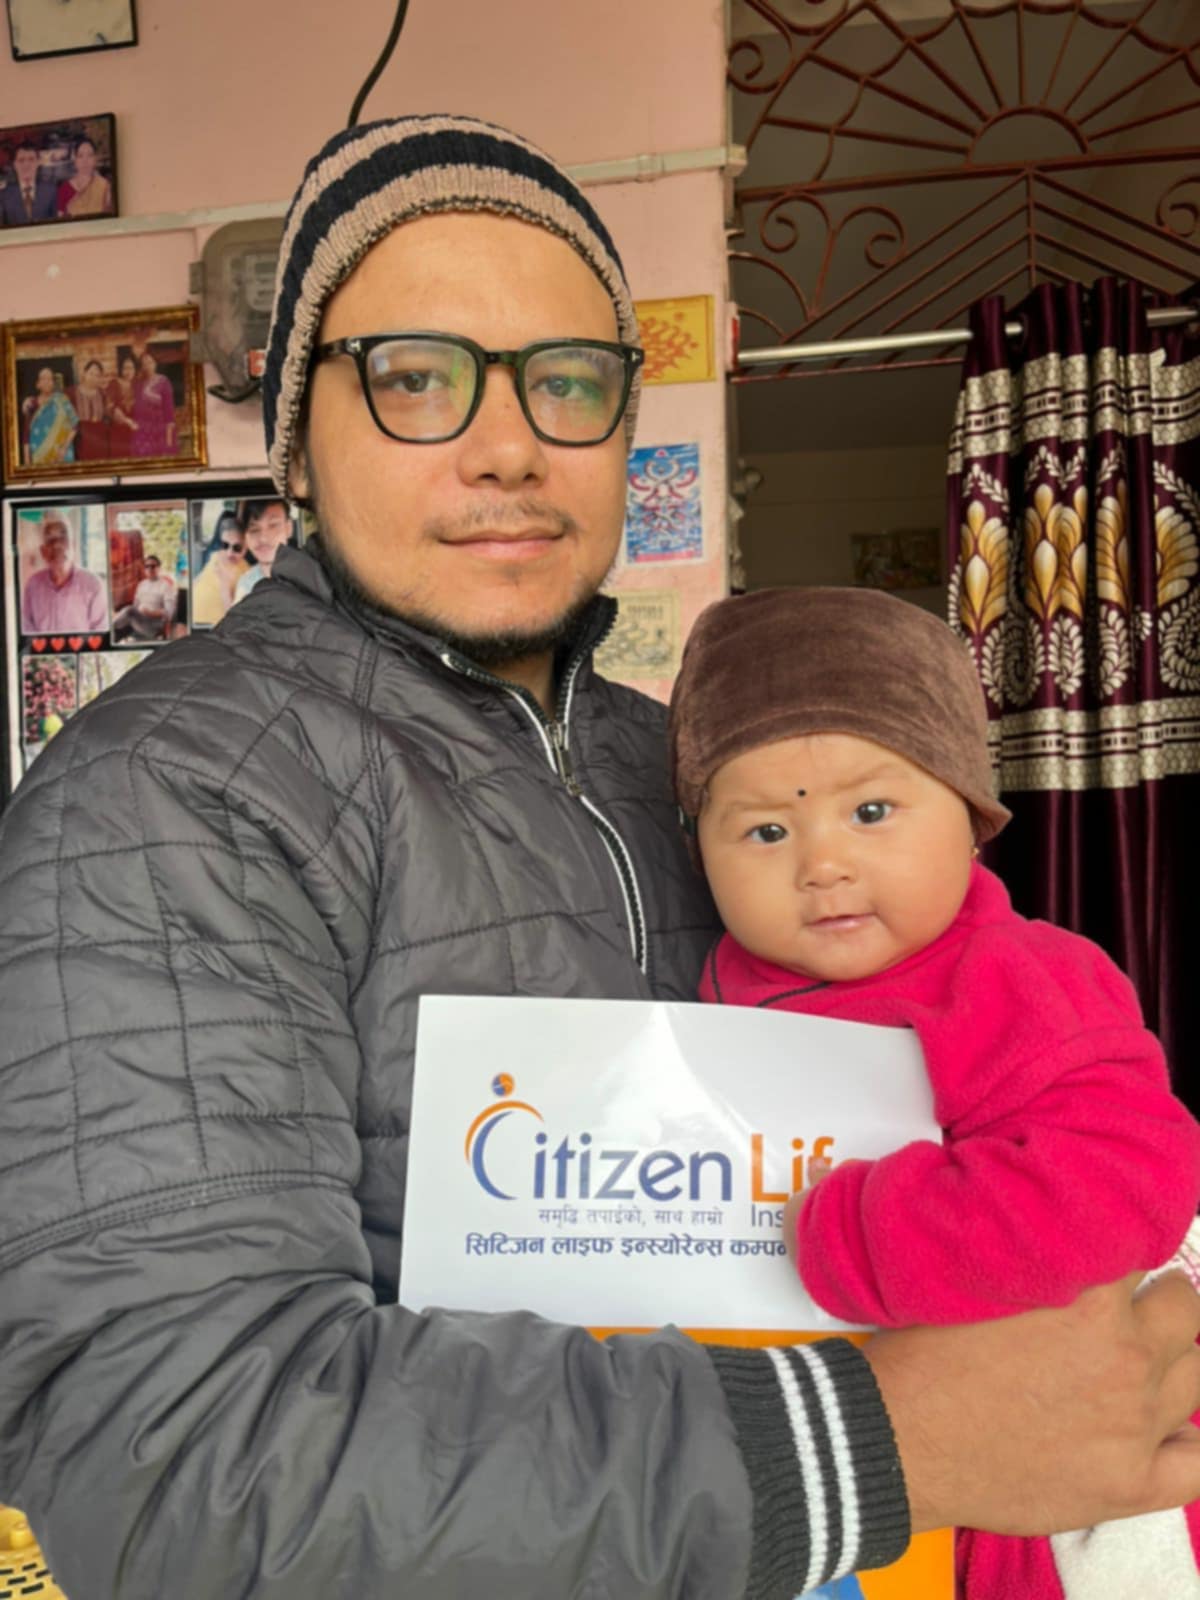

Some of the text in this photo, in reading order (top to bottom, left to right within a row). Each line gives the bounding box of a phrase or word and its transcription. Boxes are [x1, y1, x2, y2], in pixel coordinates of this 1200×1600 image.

[466, 1101, 732, 1202] Citizen
[466, 1231, 545, 1256] सिटिजन
[552, 1236, 614, 1257] लाइफ
